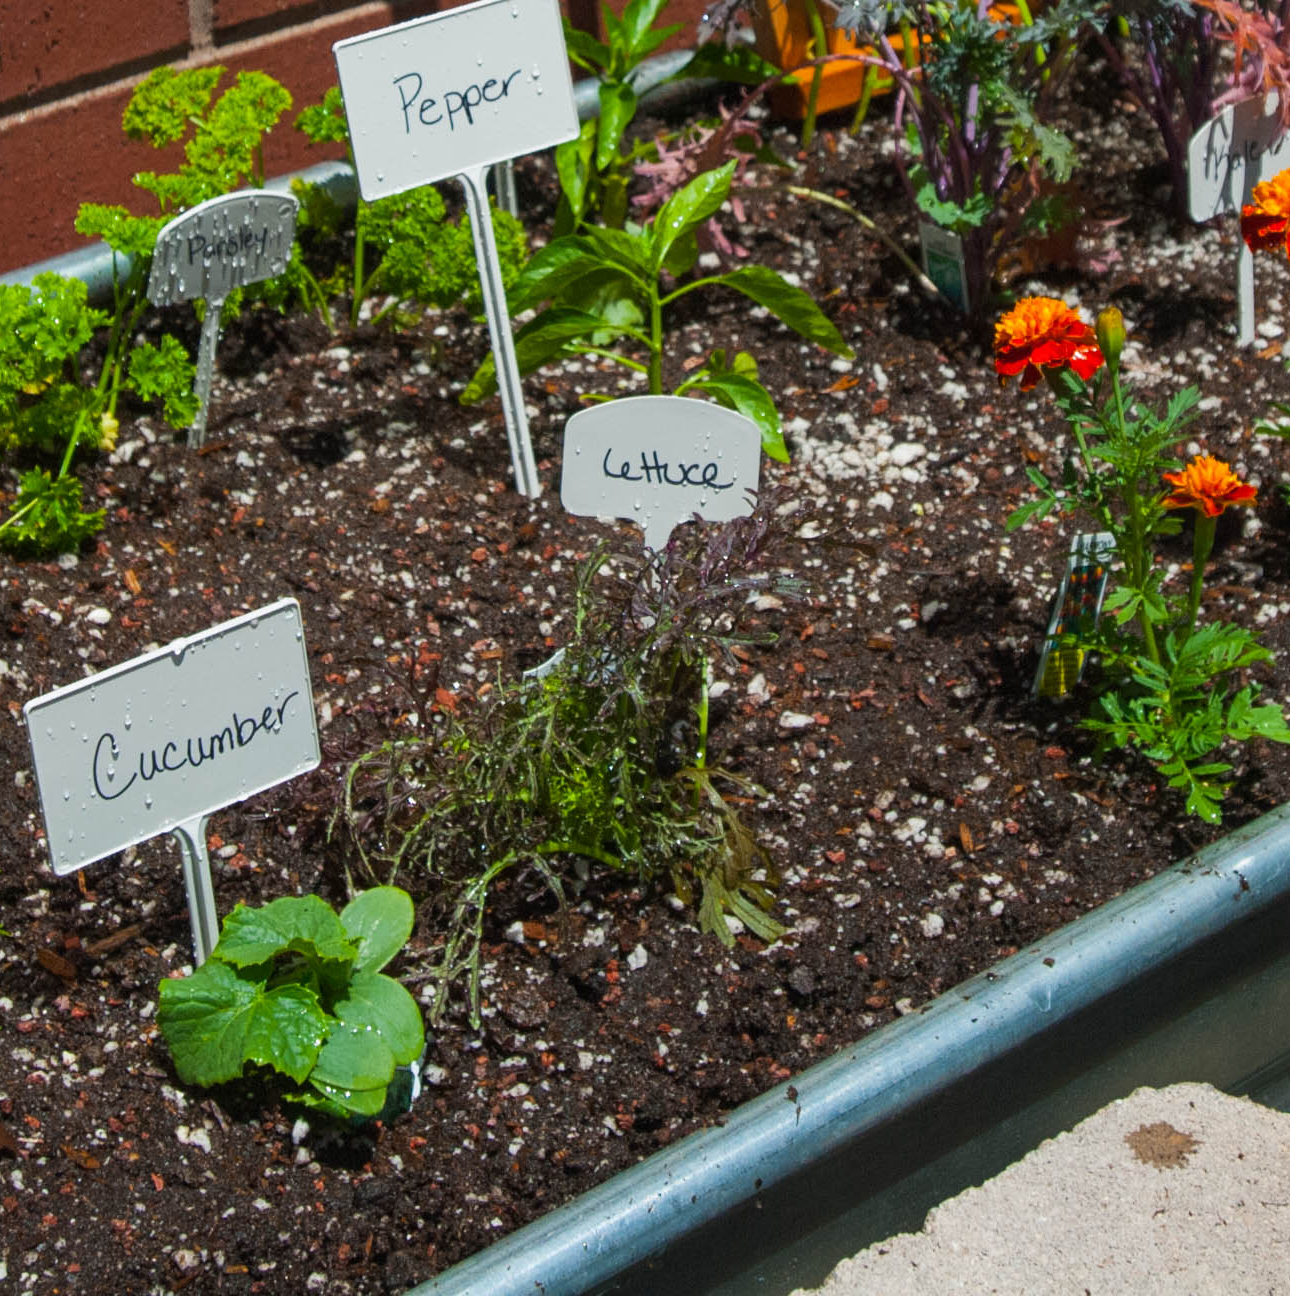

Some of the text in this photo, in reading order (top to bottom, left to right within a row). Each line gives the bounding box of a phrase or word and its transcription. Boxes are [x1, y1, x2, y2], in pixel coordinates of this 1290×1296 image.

[393, 69, 521, 134] Pepper
[187, 225, 269, 265] Parsley
[603, 448, 734, 489] Lettuce
[93, 692, 299, 800] Cucumber
